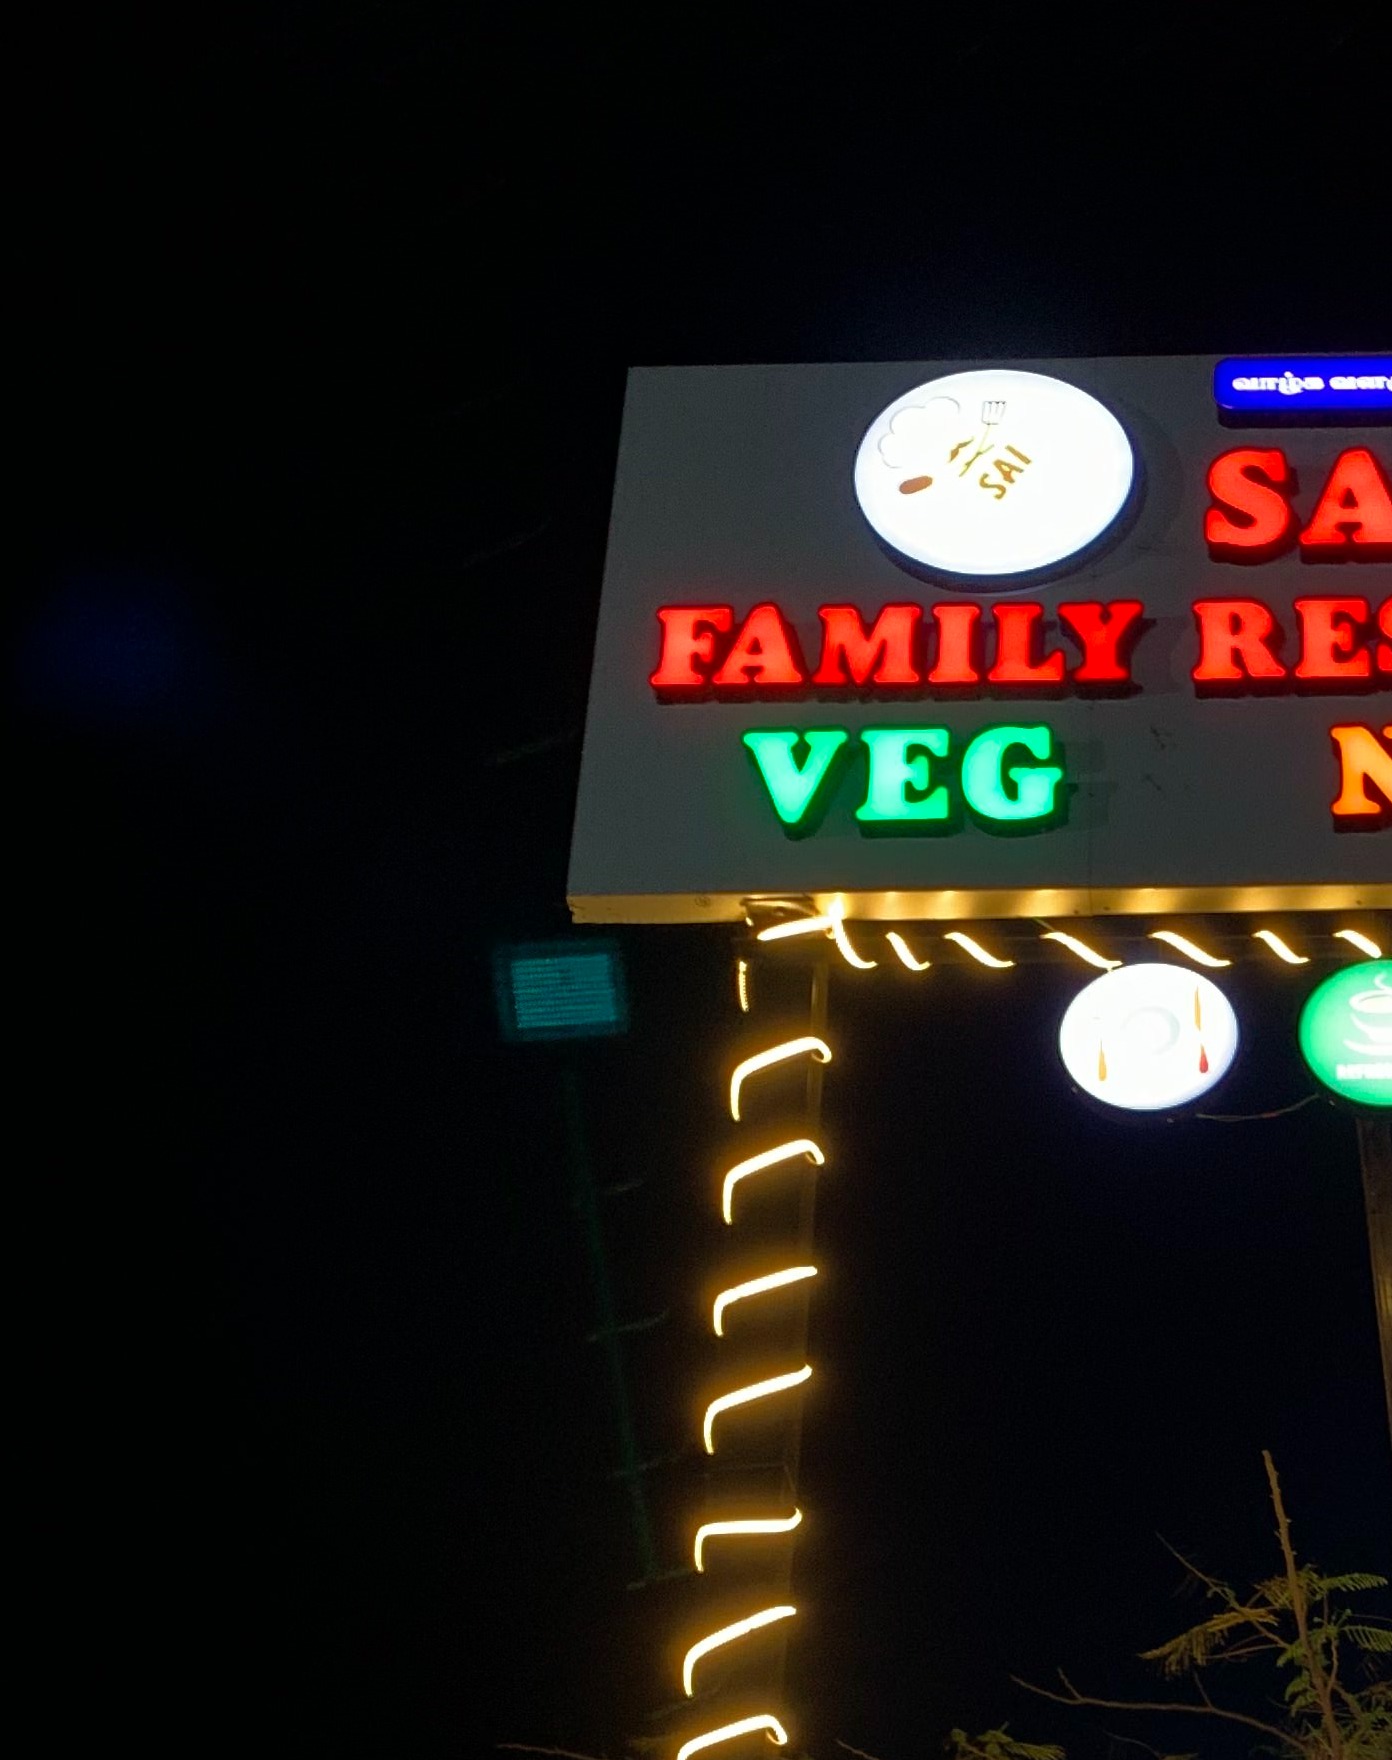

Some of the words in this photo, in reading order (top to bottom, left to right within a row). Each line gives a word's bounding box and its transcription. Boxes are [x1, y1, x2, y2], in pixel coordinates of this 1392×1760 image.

[979, 445, 1032, 500] SAI
[651, 603, 1141, 686] FAMILY
[743, 726, 1063, 823] VEG
